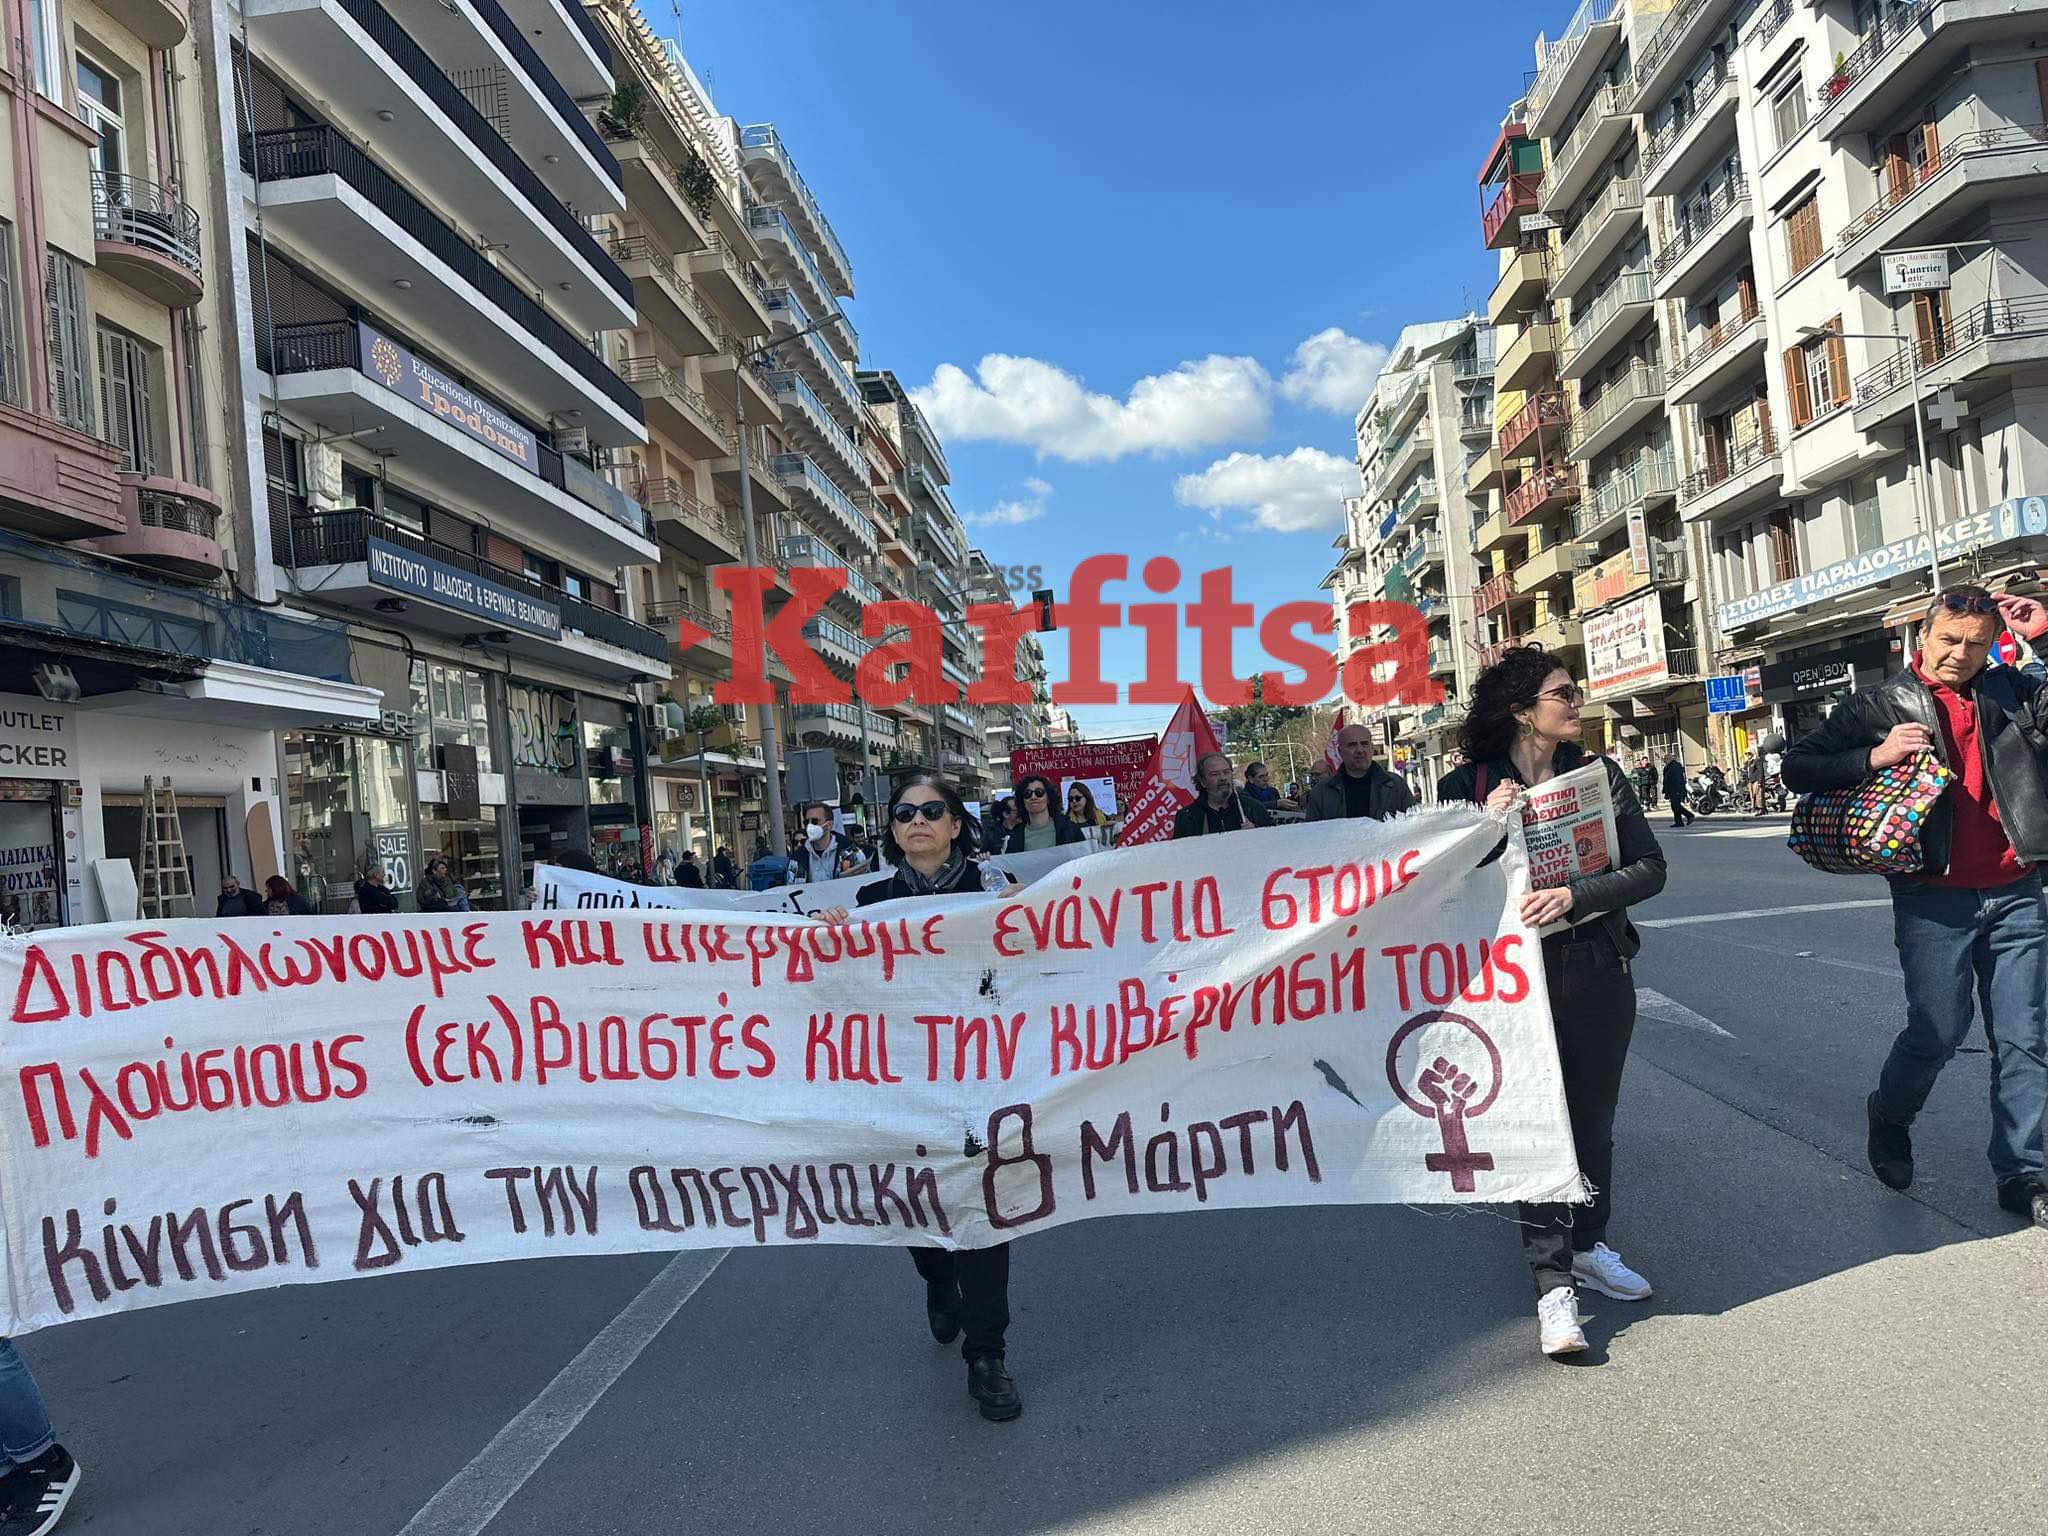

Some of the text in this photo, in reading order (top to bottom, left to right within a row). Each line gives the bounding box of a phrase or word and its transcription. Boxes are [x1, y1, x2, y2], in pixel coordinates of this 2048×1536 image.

[411, 358, 472, 409] Educational
[473, 400, 529, 445] Organization
[418, 379, 528, 462] Ipodomi
[1728, 511, 1995, 618] ΣΤΟΛΕΣ ΠΑΡΑΔΟΣΙΑΚΕΣ
[371, 547, 427, 588] ΙΝΣΤΙΤΟΥΤΟ
[433, 570, 474, 603] ΔΙΑΔΟΣΗΣ
[476, 586, 483, 606] &
[483, 588, 517, 617] ΕΡΕΥΝΑΣ
[1793, 661, 1847, 684] OPEN BOX
[0, 710, 64, 732] UTLET
[379, 837, 408, 854] SALE
[1525, 831, 1559, 846] ΕΡΝΗΣΗ
[1527, 838, 1562, 853] ΟΦΟΝΩΝ
[1536, 843, 1572, 862] ΤΟΥΣ
[1529, 856, 1573, 877] ΝΑΤΡΕ-
[1531, 870, 1569, 890] ΟΥΜΕ
[11, 922, 496, 1023] Διαδηλώνουμε
[523, 919, 623, 969] και
[993, 876, 1237, 957] ενάντια
[1261, 848, 1420, 930] στους
[805, 1012, 901, 1085] και
[914, 1013, 1026, 1082] την
[1381, 934, 1530, 1011] τους
[348, 1176, 466, 1271] για
[484, 1165, 598, 1237] την
[629, 1143, 953, 1243] απεργιακή
[982, 1102, 1056, 1230] 8
[1080, 1101, 1322, 1202] Μάρτη
